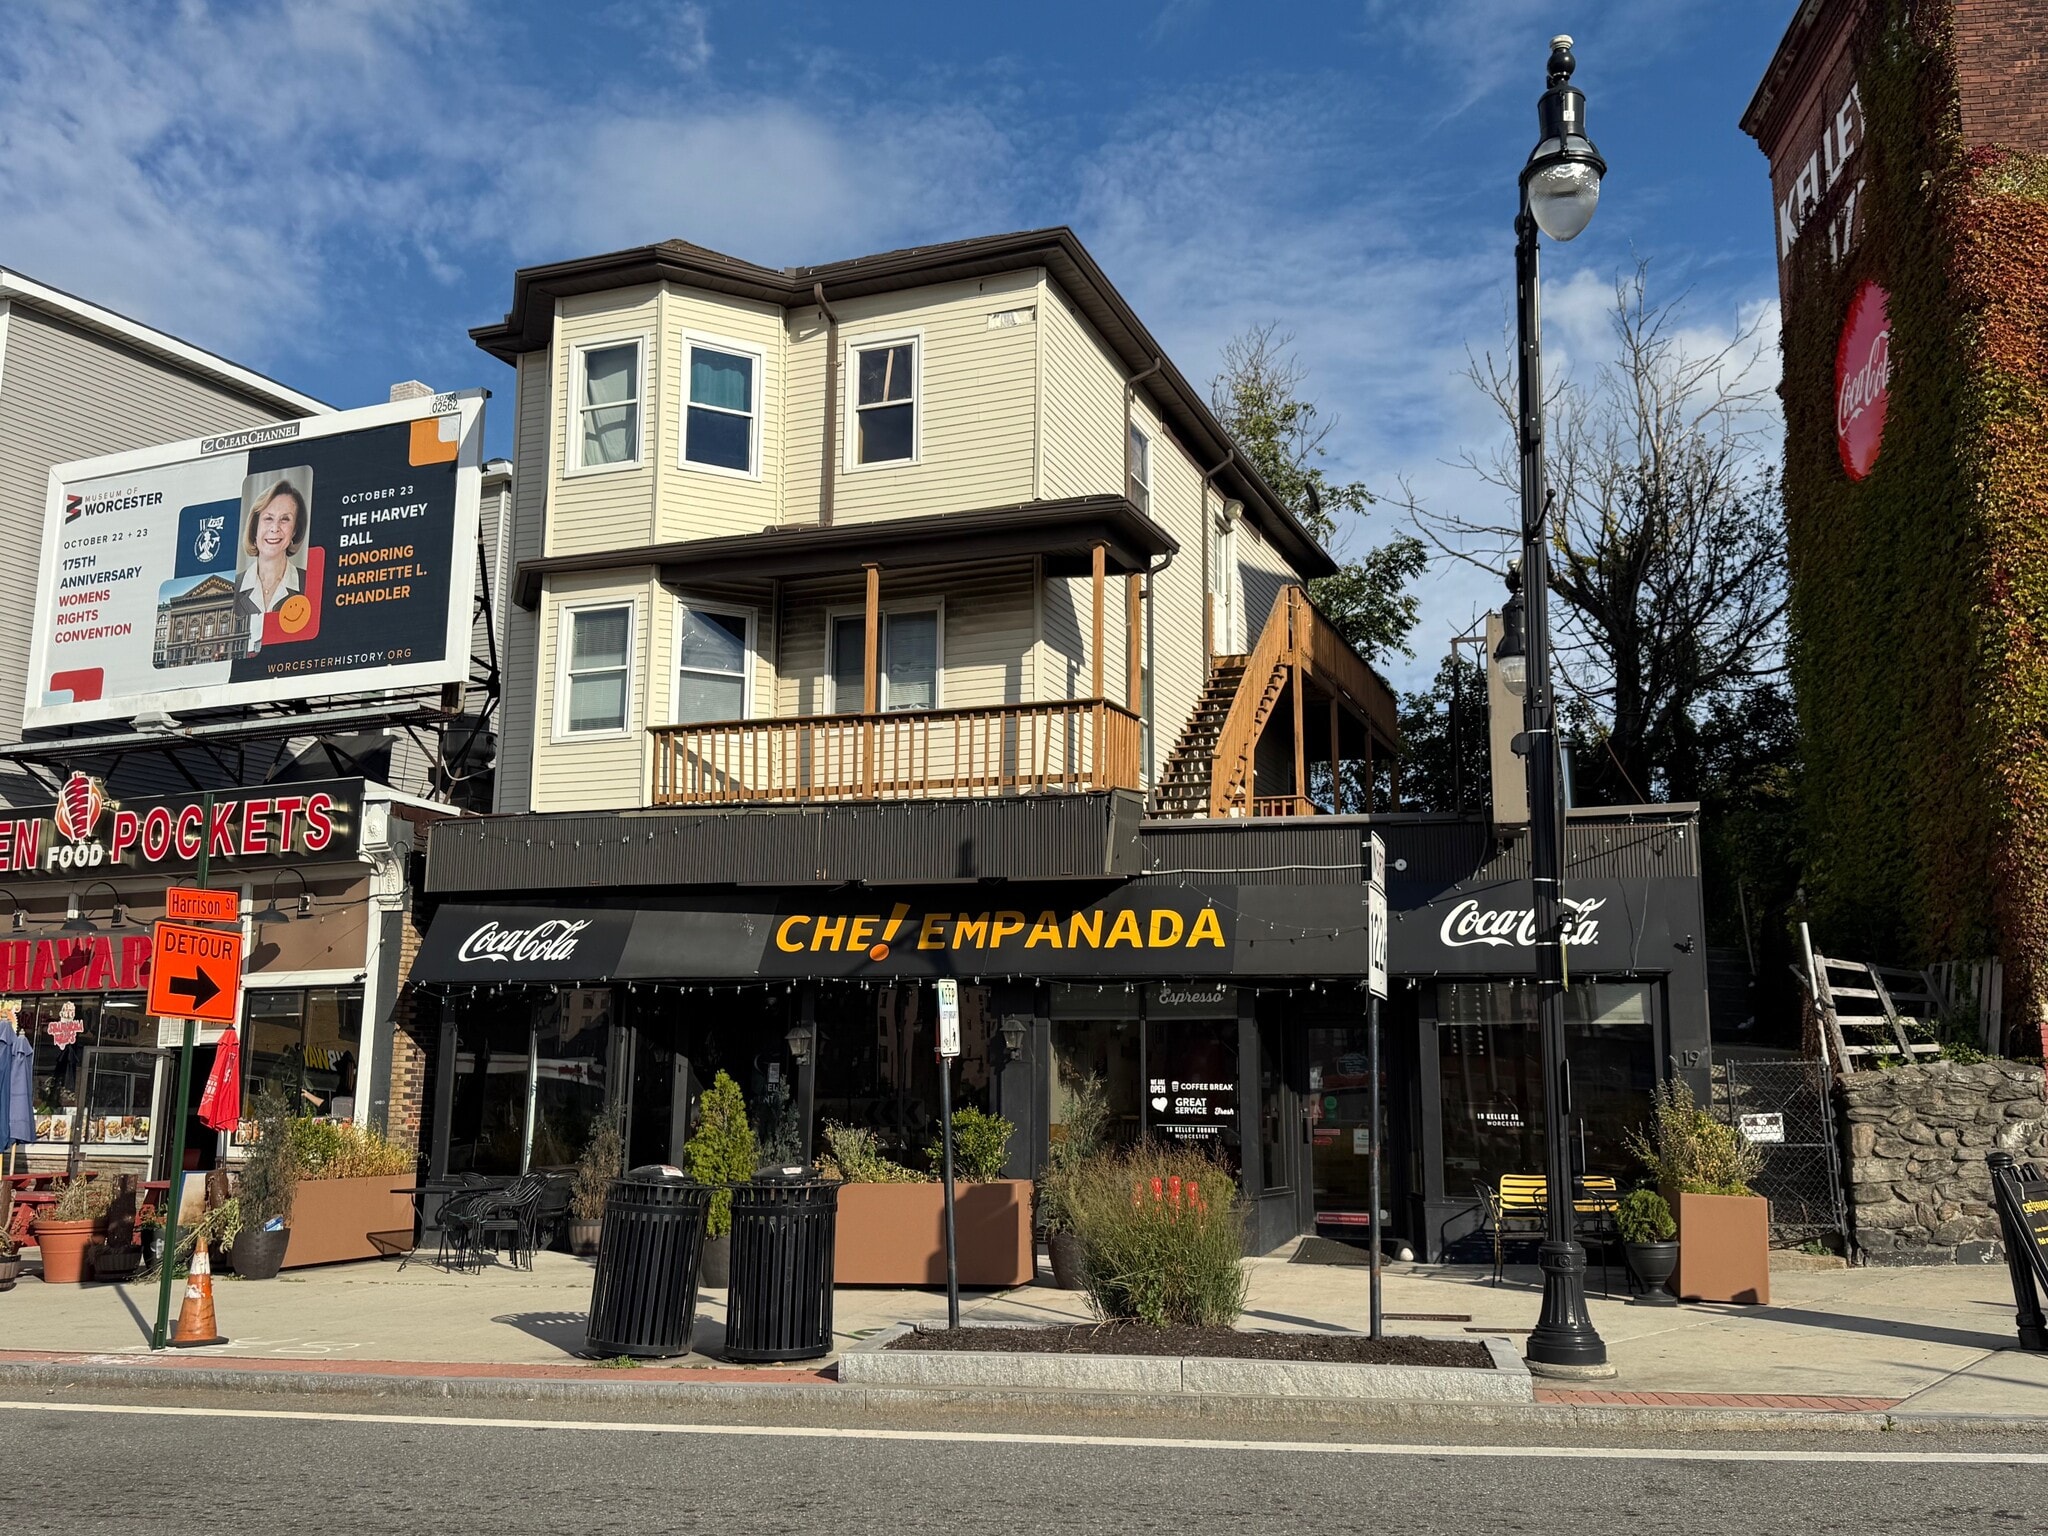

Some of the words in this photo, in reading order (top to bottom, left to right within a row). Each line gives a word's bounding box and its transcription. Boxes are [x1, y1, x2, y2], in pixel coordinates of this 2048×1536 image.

[1838, 330, 1890, 436] Coca-Col
[432, 400, 458, 413] 02562
[85, 491, 122, 502] MUSEUM
[126, 487, 139, 495] OF
[85, 492, 163, 517] WORCESTER
[342, 488, 395, 504] OCTOBER
[400, 485, 414, 496] 23
[341, 512, 367, 528] THE
[371, 503, 428, 524] HARVEY
[63, 535, 108, 550] OCTOBER
[112, 532, 124, 542] 22
[136, 528, 149, 538] 23
[339, 531, 373, 547] BALL
[62, 555, 96, 571] 175TH
[338, 545, 414, 567] HONORING
[60, 566, 142, 589] ANNIVERSARY
[336, 565, 412, 587] HARRIETTE
[416, 563, 428, 577] L.
[58, 589, 111, 607] WOMENS
[335, 585, 411, 607] CHANDLER
[56, 609, 99, 626] RIGHTS
[54, 623, 132, 643] CONVENTION
[267, 648, 412, 673] WORCESTERHISTORY.ORG
[110, 792, 334, 864] POCKETS
[46, 843, 102, 869] FOOD
[172, 893, 220, 916] Harrison
[225, 897, 234, 911] St
[775, 903, 911, 962] CHE!
[917, 908, 1227, 951] EMPANADA
[1440, 897, 1607, 948] Coca-Cla
[164, 931, 233, 961] DETOUR
[458, 919, 594, 962] Coca-Cola
[1159, 988, 1224, 1006] Espresso
[1682, 1050, 1700, 1067] 19
[1150, 1085, 1166, 1094] OPEN
[1180, 1083, 1208, 1091] COFFEE
[1209, 1083, 1233, 1091] BREAK
[1175, 1098, 1207, 1107] GREAT
[1175, 1107, 1207, 1115] SERVICE
